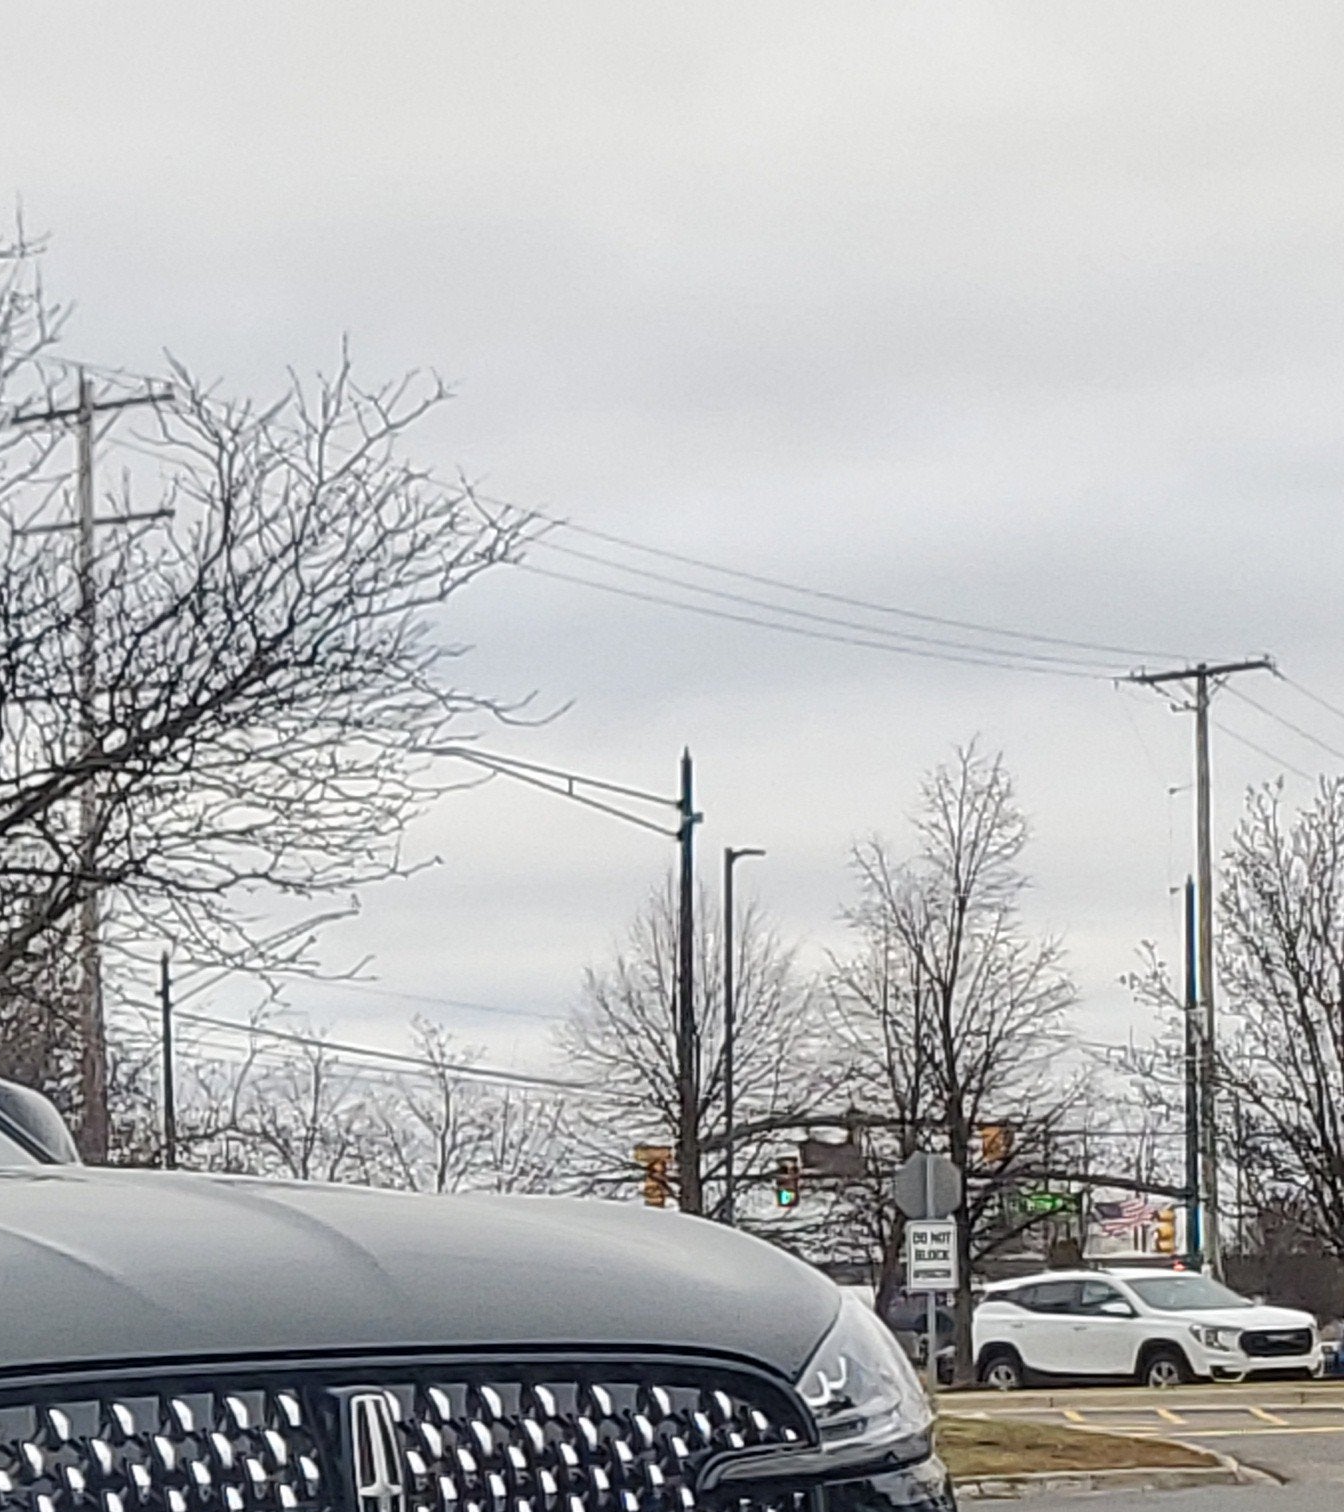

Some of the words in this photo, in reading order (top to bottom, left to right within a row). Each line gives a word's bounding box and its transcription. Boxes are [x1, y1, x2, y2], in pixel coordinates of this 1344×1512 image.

[913, 1232, 928, 1245] DO
[931, 1231, 951, 1245] NOT
[914, 1249, 950, 1261] BLOCK
